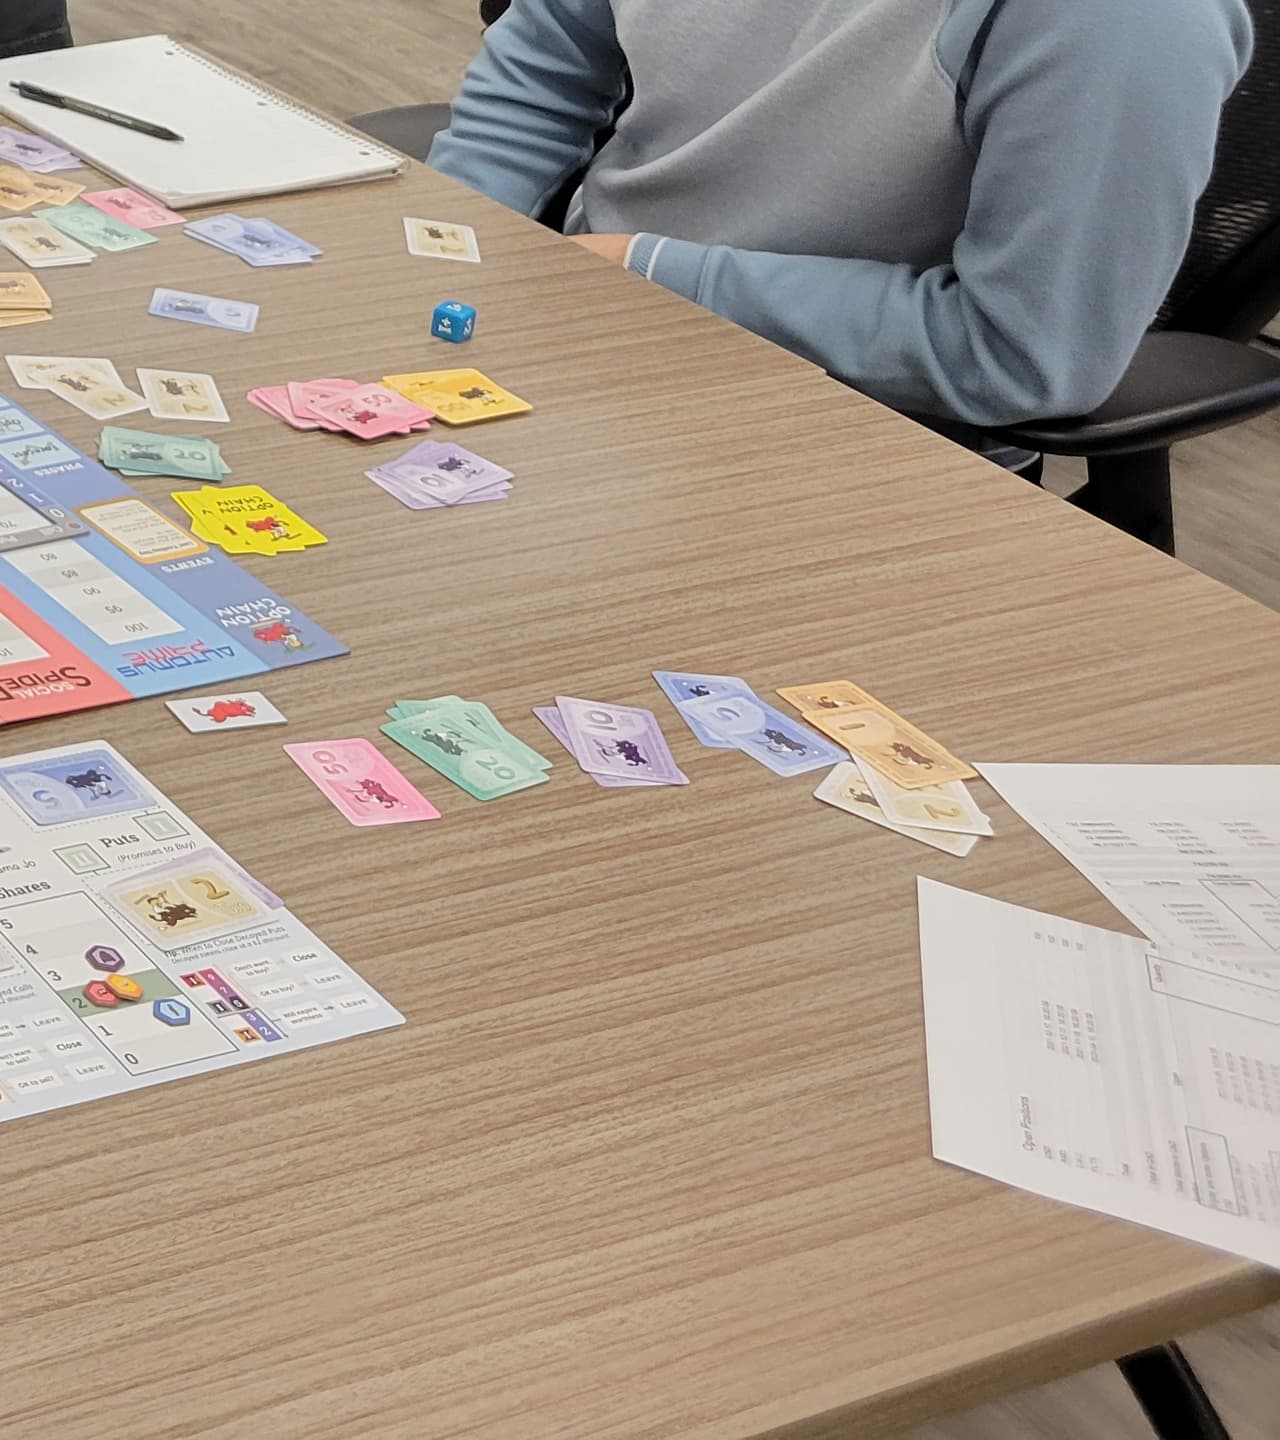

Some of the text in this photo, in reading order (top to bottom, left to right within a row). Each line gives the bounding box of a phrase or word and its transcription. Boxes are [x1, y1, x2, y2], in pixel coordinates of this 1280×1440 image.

[217, 496, 263, 507] CHAIN
[220, 502, 274, 514] OPTION
[41, 552, 57, 562] 80
[62, 569, 78, 579] 85
[83, 587, 100, 597] 90
[105, 604, 123, 615] 95
[216, 597, 276, 615] CHAIN
[220, 606, 290, 627] OPTION
[124, 622, 148, 633] 100
[117, 645, 235, 678] AUTOMUS
[13, 682, 74, 700] SOCIAL
[100, 832, 140, 849] Puts
[23, 859, 36, 871] Jo
[0, 919, 13, 930] 5
[26, 944, 38, 955] 4
[47, 970, 62, 982] 3
[73, 997, 88, 1010] 2
[98, 1025, 113, 1037] 1
[56, 1040, 82, 1050] Close
[124, 1052, 139, 1065] 0
